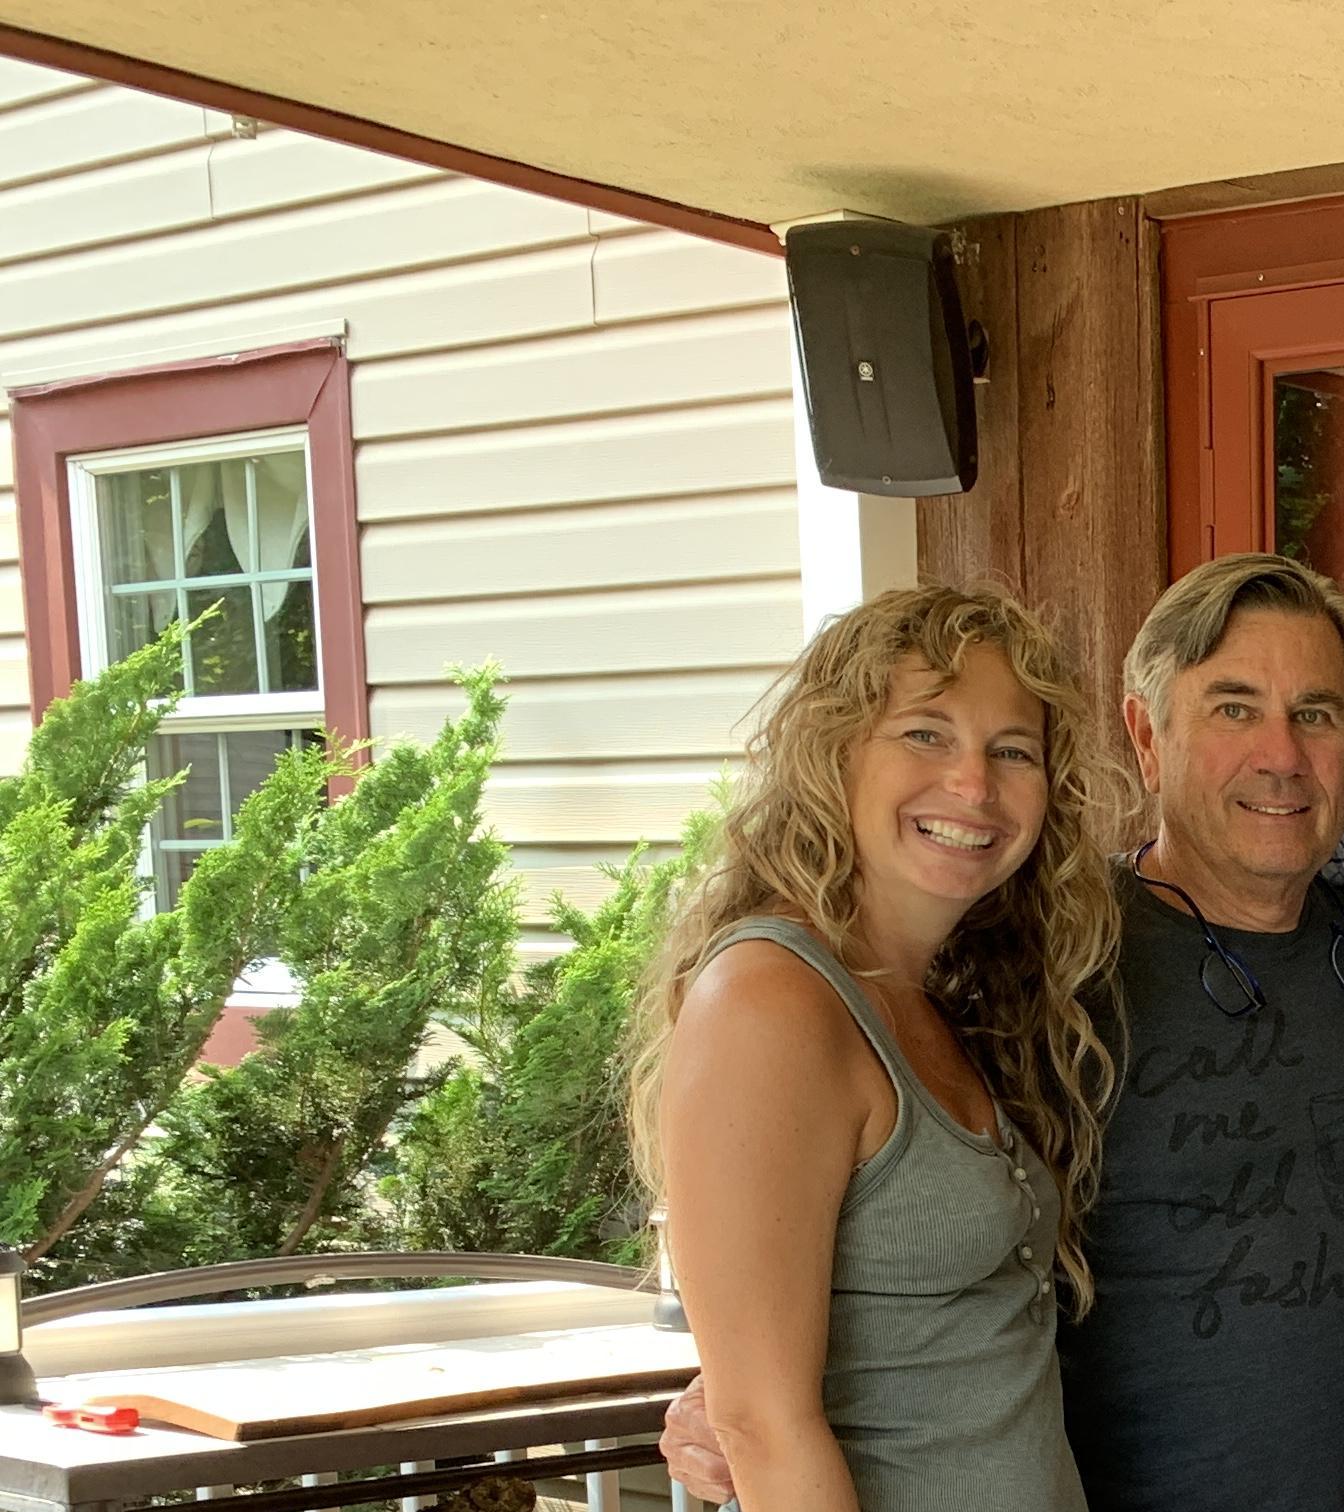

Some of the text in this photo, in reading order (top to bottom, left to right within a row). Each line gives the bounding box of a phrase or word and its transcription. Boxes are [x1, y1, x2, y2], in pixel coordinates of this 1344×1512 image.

[1131, 1006, 1304, 1098] call
[1168, 1101, 1276, 1152] me
[1168, 1149, 1297, 1232] old
